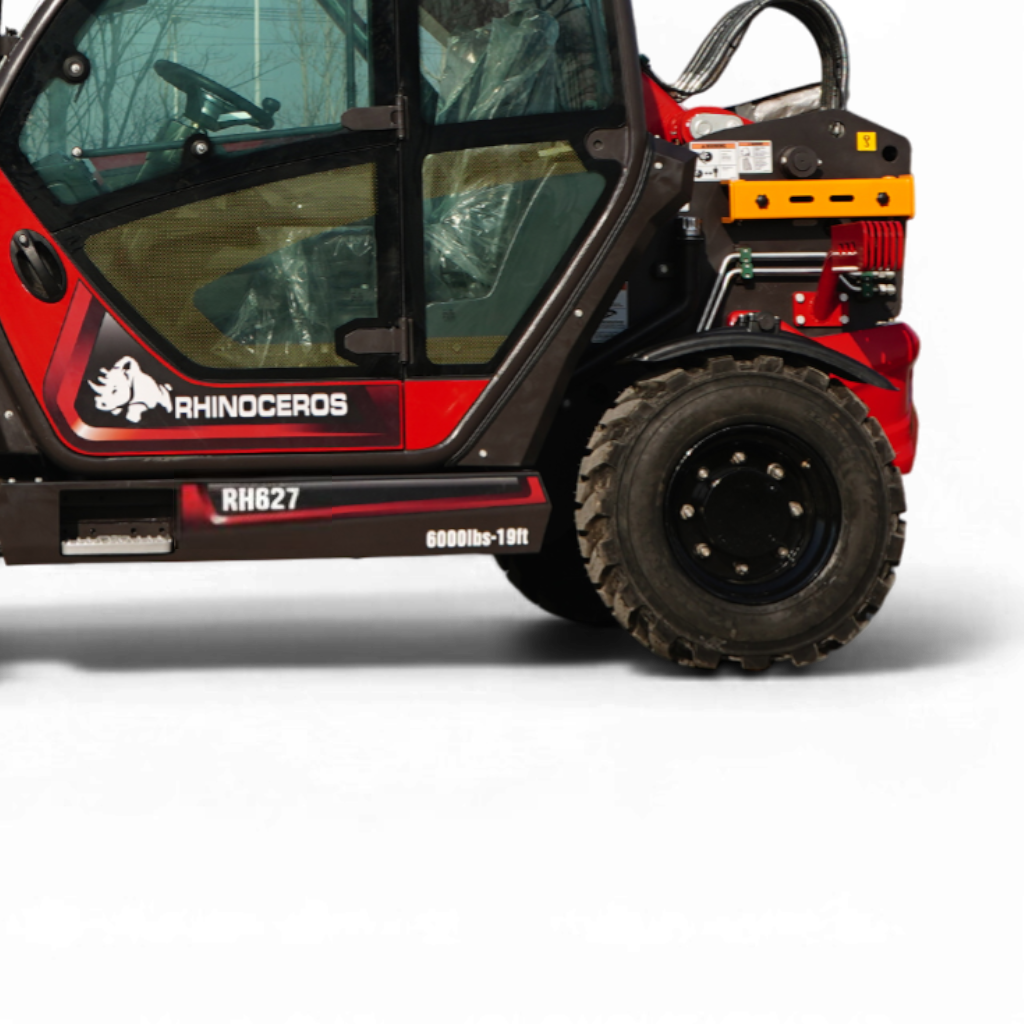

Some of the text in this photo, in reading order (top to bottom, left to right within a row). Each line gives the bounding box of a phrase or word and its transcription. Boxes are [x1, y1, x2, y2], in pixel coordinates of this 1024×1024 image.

[175, 393, 348, 418] RHINOCEROS
[222, 487, 300, 512] RH627
[426, 527, 529, 549] 6000lbs-19ft
